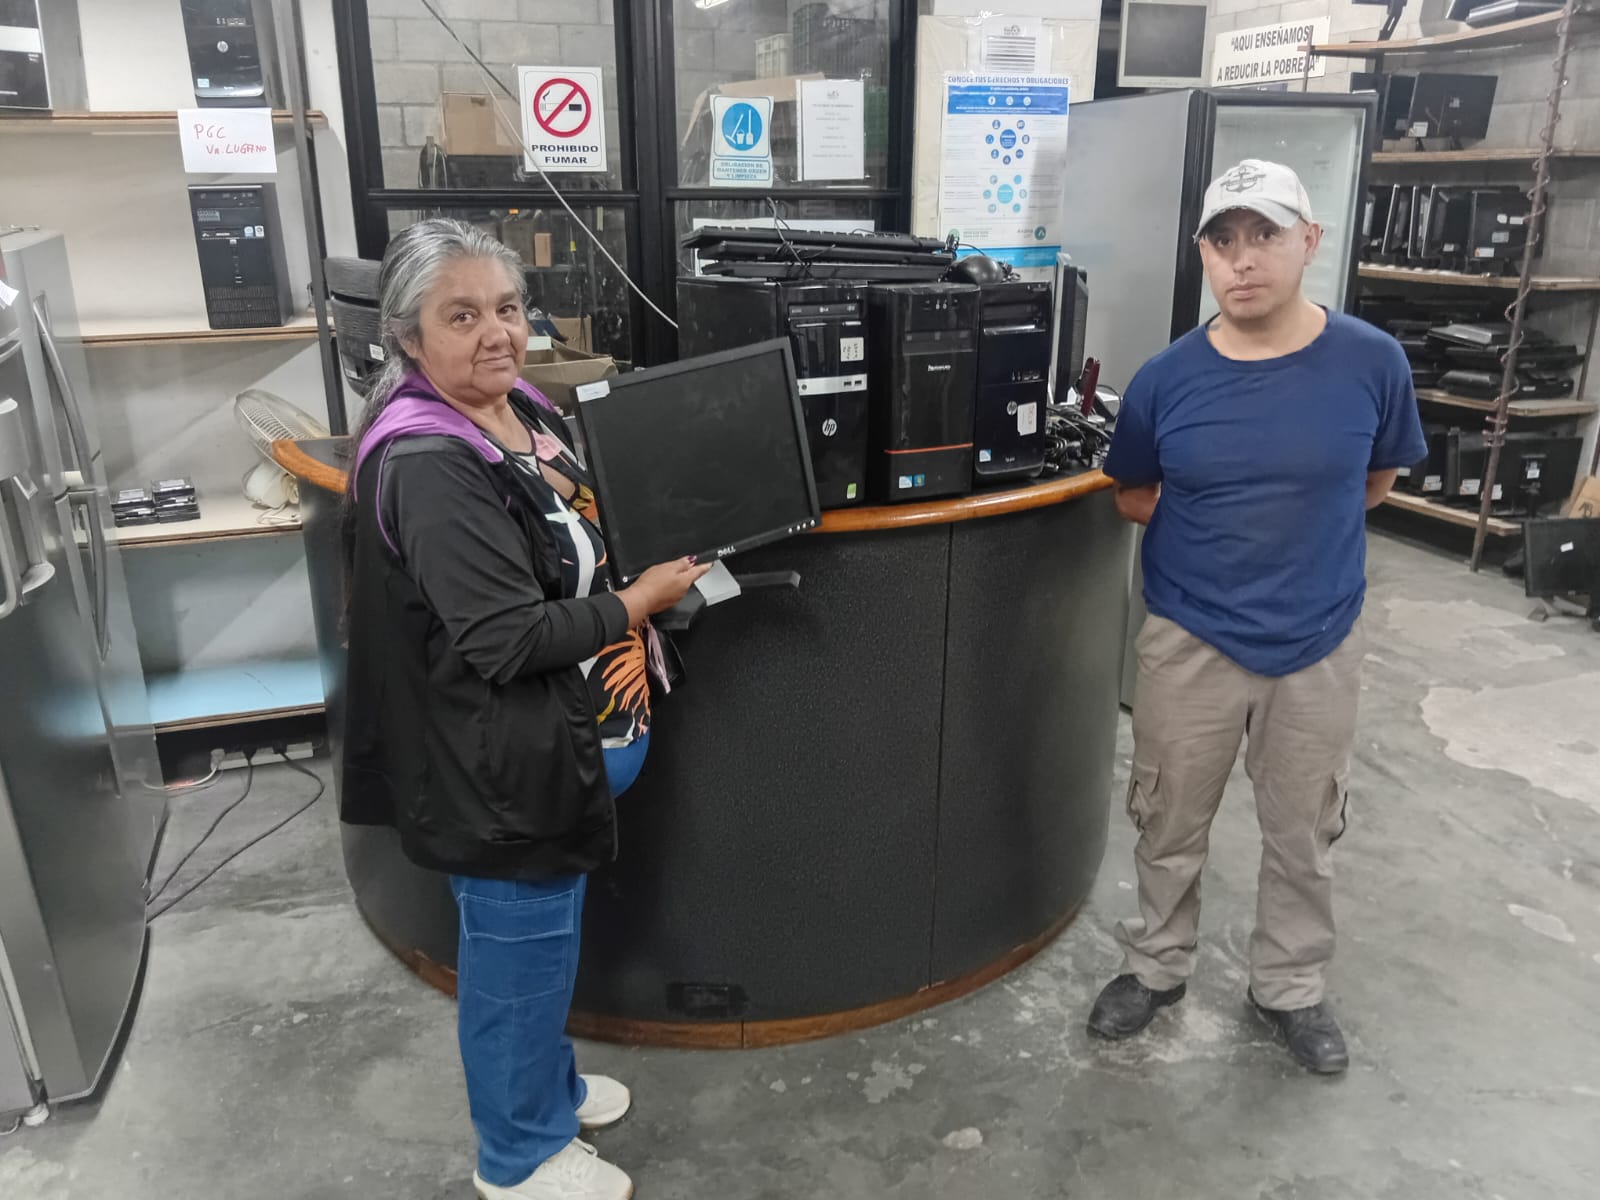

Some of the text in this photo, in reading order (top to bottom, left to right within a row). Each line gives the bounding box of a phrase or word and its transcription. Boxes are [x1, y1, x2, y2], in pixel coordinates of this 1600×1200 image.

[1217, 56, 1320, 82] A REDUCIR LA POBREA"
[531, 144, 599, 153] PROHIBIDO
[544, 156, 588, 164] FUMAR
[822, 418, 838, 437] hp
[717, 545, 736, 558] DELL
